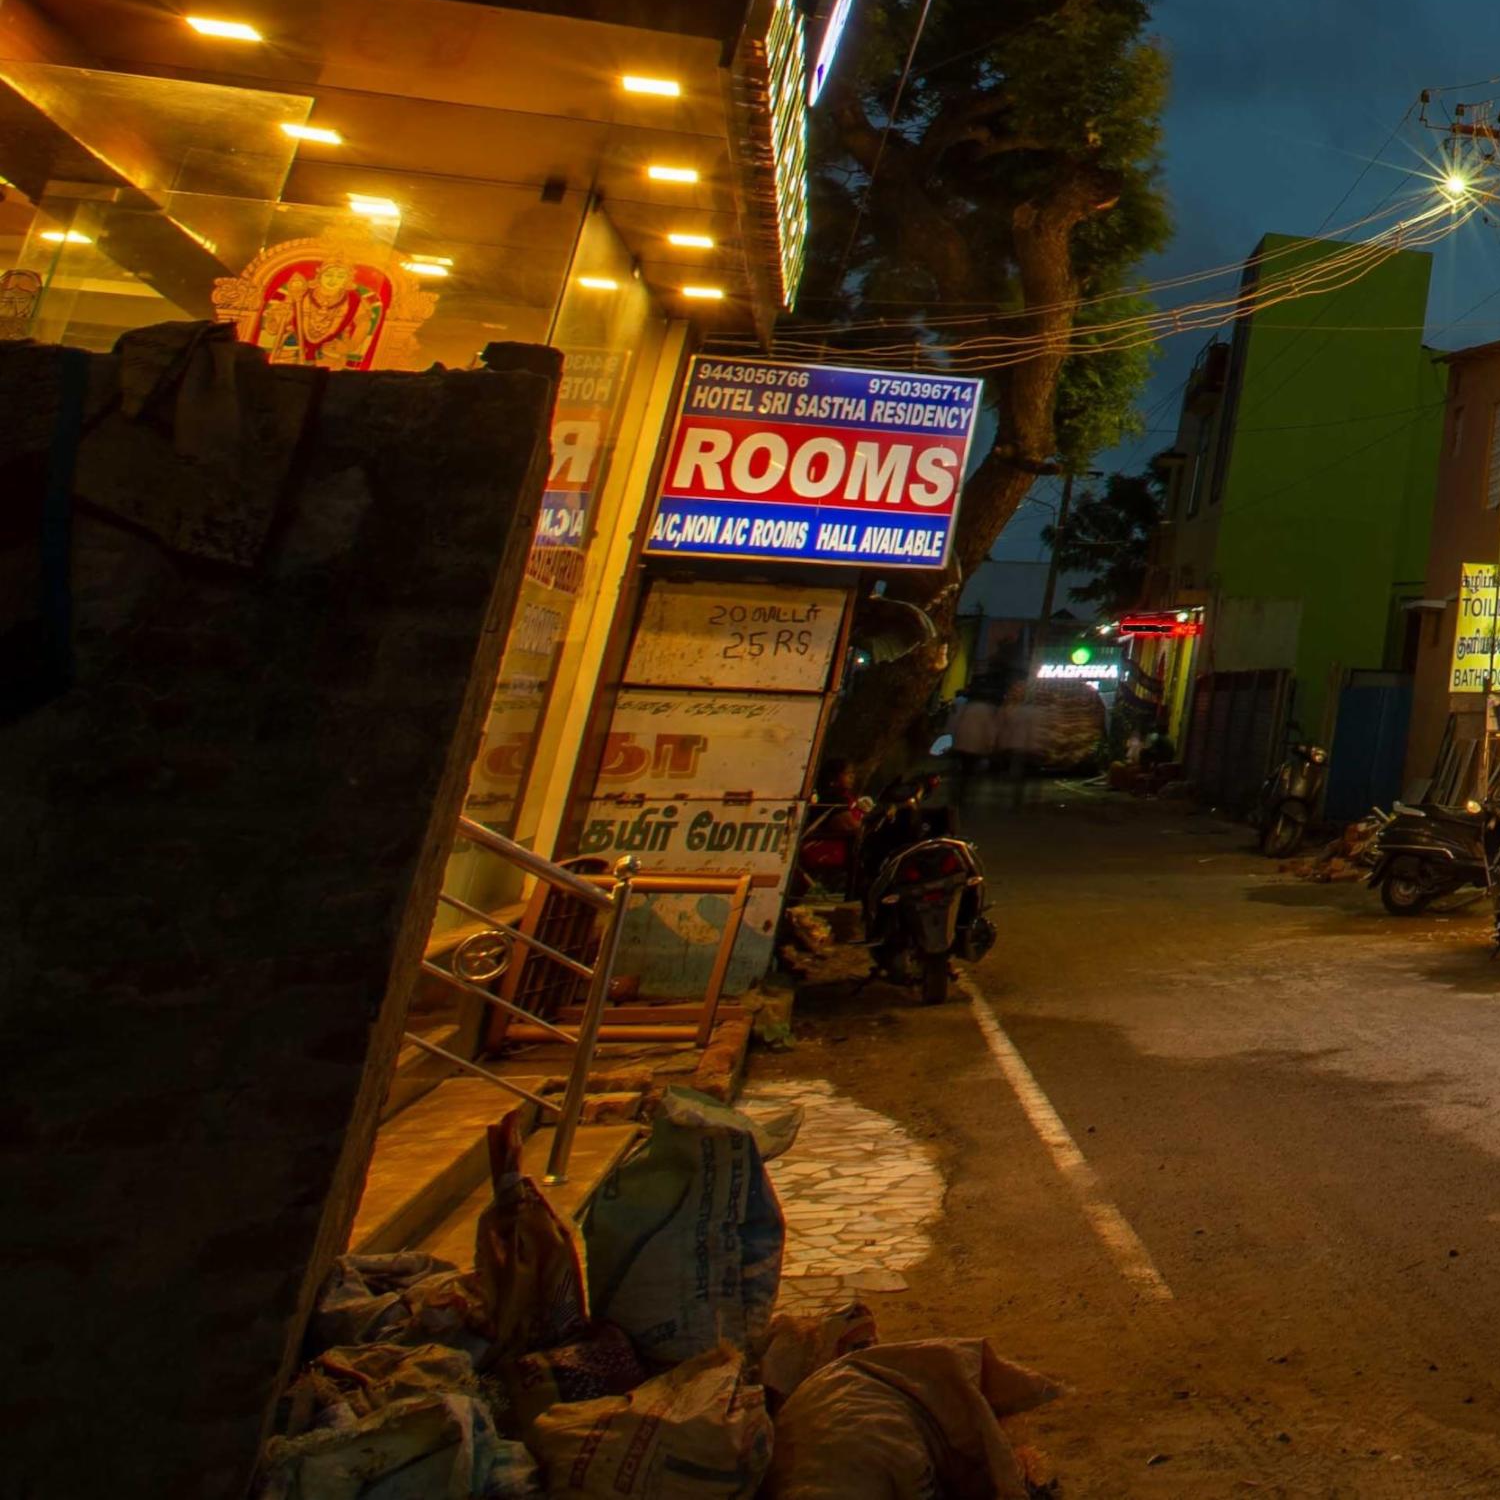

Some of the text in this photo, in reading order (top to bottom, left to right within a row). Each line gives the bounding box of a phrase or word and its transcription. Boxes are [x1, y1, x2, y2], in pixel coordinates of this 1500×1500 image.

[698, 362, 974, 402] 9443056766 9750396714
[691, 385, 973, 431] HOTEL SRI SASTHA RESIDENCY
[671, 426, 961, 507] ROOMS
[719, 517, 749, 546] A/C
[749, 520, 810, 550] ROOMS
[815, 523, 857, 552] HALL
[859, 526, 945, 557] AVAILABLE
[708, 605, 748, 625] 20
[722, 629, 813, 659] 25 RS
[581, 804, 788, 854] தயிர் மோர்
